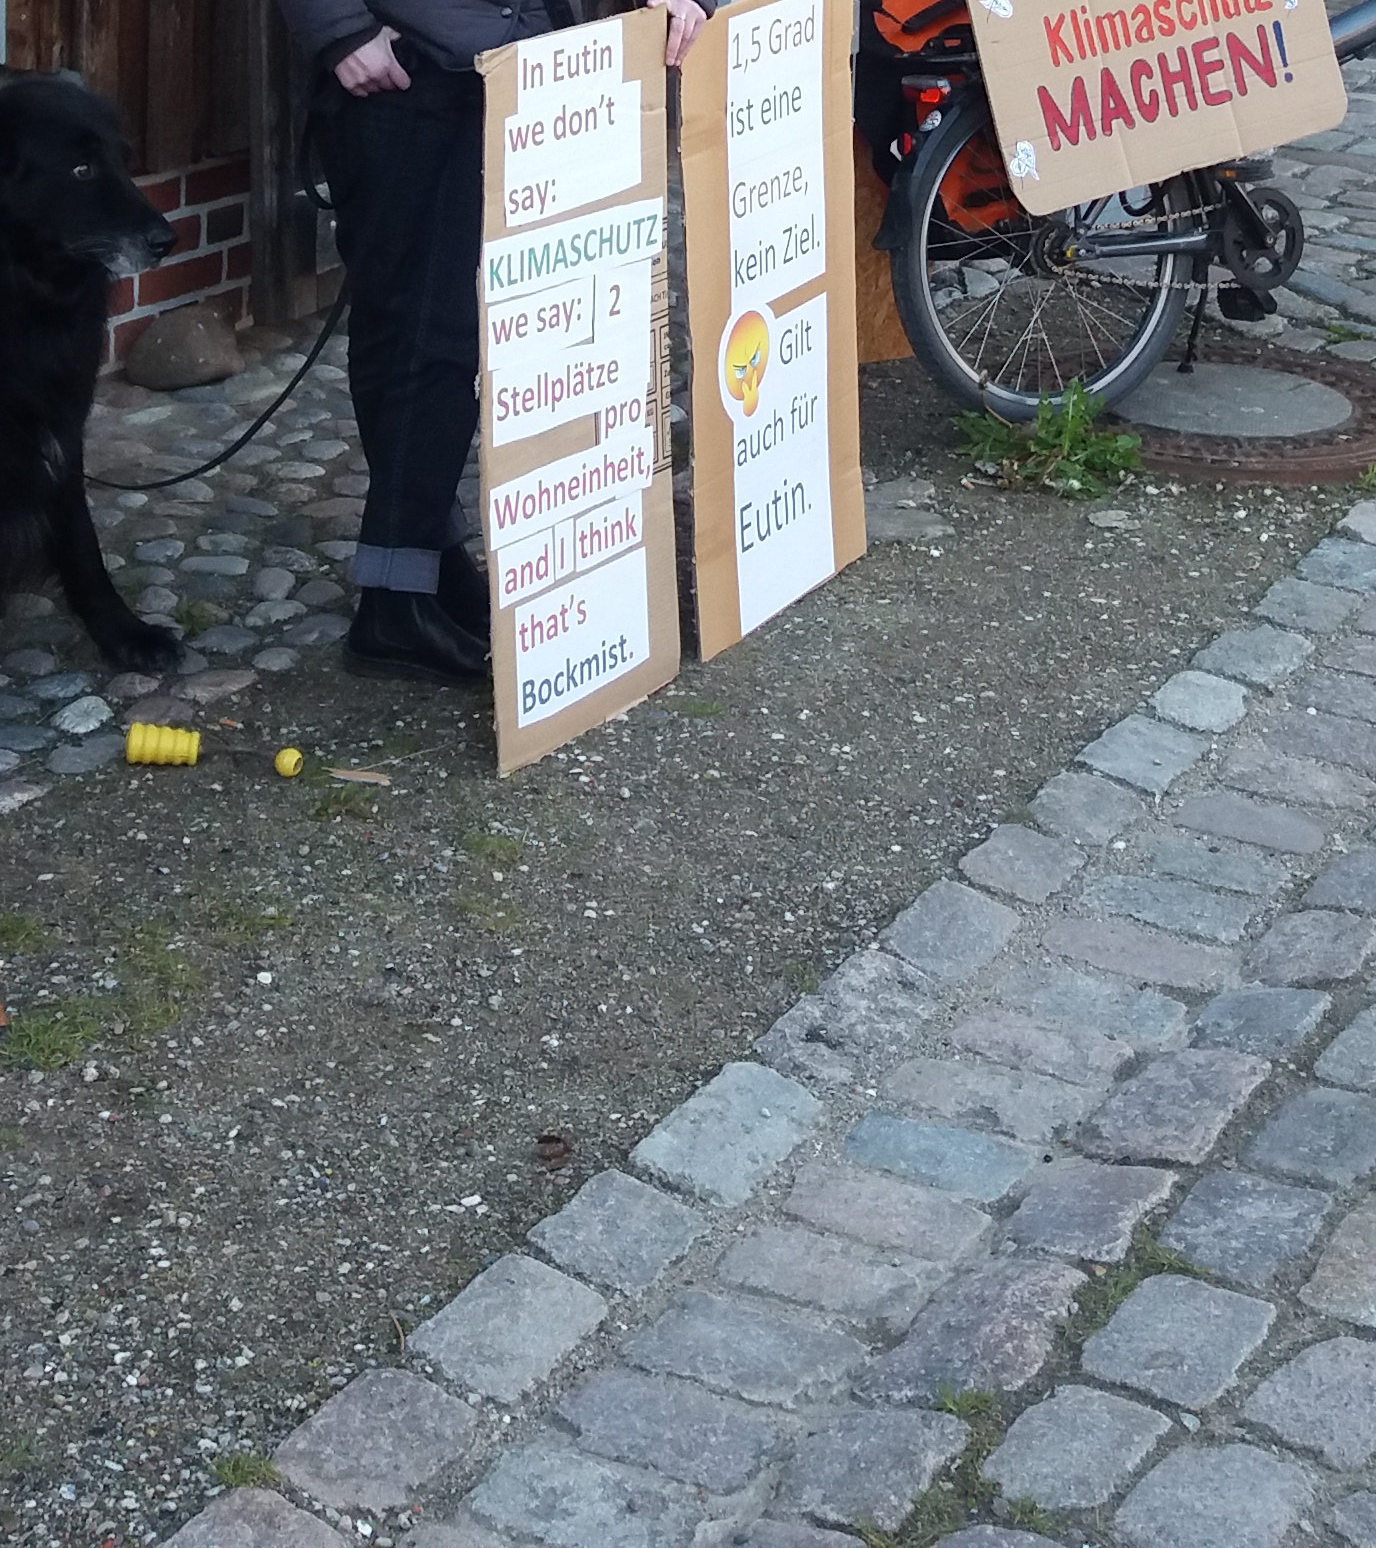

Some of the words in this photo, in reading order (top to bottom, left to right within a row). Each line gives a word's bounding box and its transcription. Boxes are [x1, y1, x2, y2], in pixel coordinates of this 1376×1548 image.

[522, 57, 544, 91] In
[553, 39, 613, 84] Eutin
[732, 24, 762, 75] 1,5
[768, 5, 816, 55] Grad
[729, 99, 754, 139] ist
[761, 84, 803, 125] eine
[1037, 20, 1294, 152] MACHEN!
[509, 119, 545, 153] we
[508, 176, 558, 216] say:
[732, 165, 810, 220] Grenze,
[489, 214, 659, 292] KLIMASCHUTZ
[734, 238, 776, 290] kein
[782, 214, 822, 266] Ziel.
[492, 313, 529, 346] we
[536, 295, 583, 336] say:
[607, 283, 622, 318] 2
[779, 319, 813, 366] Gilt
[496, 357, 620, 423] Stellplätze
[604, 397, 642, 441] pro
[737, 409, 784, 468] auch
[790, 392, 819, 437] für
[493, 445, 652, 531] Wohneinheit,
[738, 479, 813, 554] Eutin.
[504, 549, 549, 595] and
[578, 508, 638, 561] think
[521, 634, 635, 715] Bockmist.
